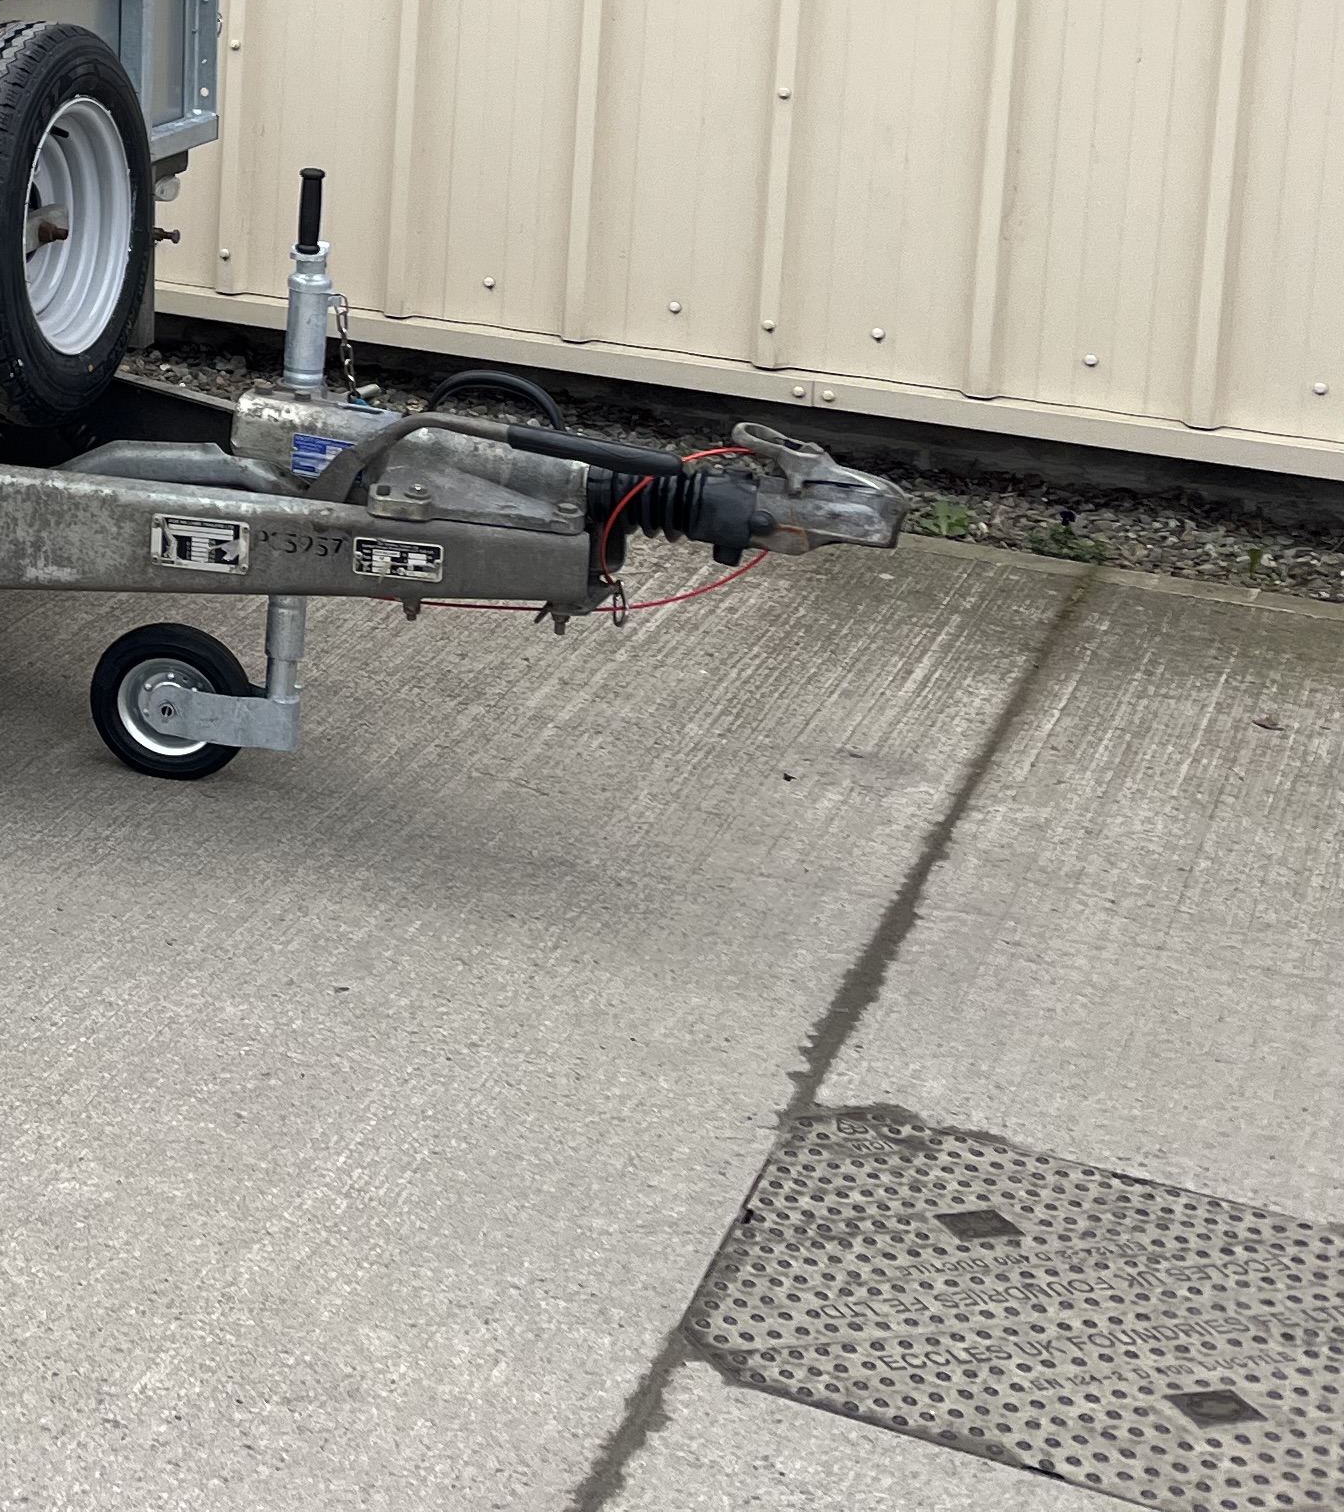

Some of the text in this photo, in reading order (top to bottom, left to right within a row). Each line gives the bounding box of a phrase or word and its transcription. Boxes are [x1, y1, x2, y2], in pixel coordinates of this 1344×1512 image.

[894, 1258, 990, 1277] DUCTILE
[1165, 1257, 1292, 1282] ECCLES
[1113, 1270, 1167, 1289] UK
[934, 1277, 1116, 1309] FOUNDRIES
[820, 1301, 881, 1320] LTD
[878, 1344, 1013, 1372] ECCLES
[1013, 1339, 1068, 1359] UK
[1065, 1316, 1251, 1353] FOUNDRIES
[1197, 1350, 1297, 1372] DUCTILE
